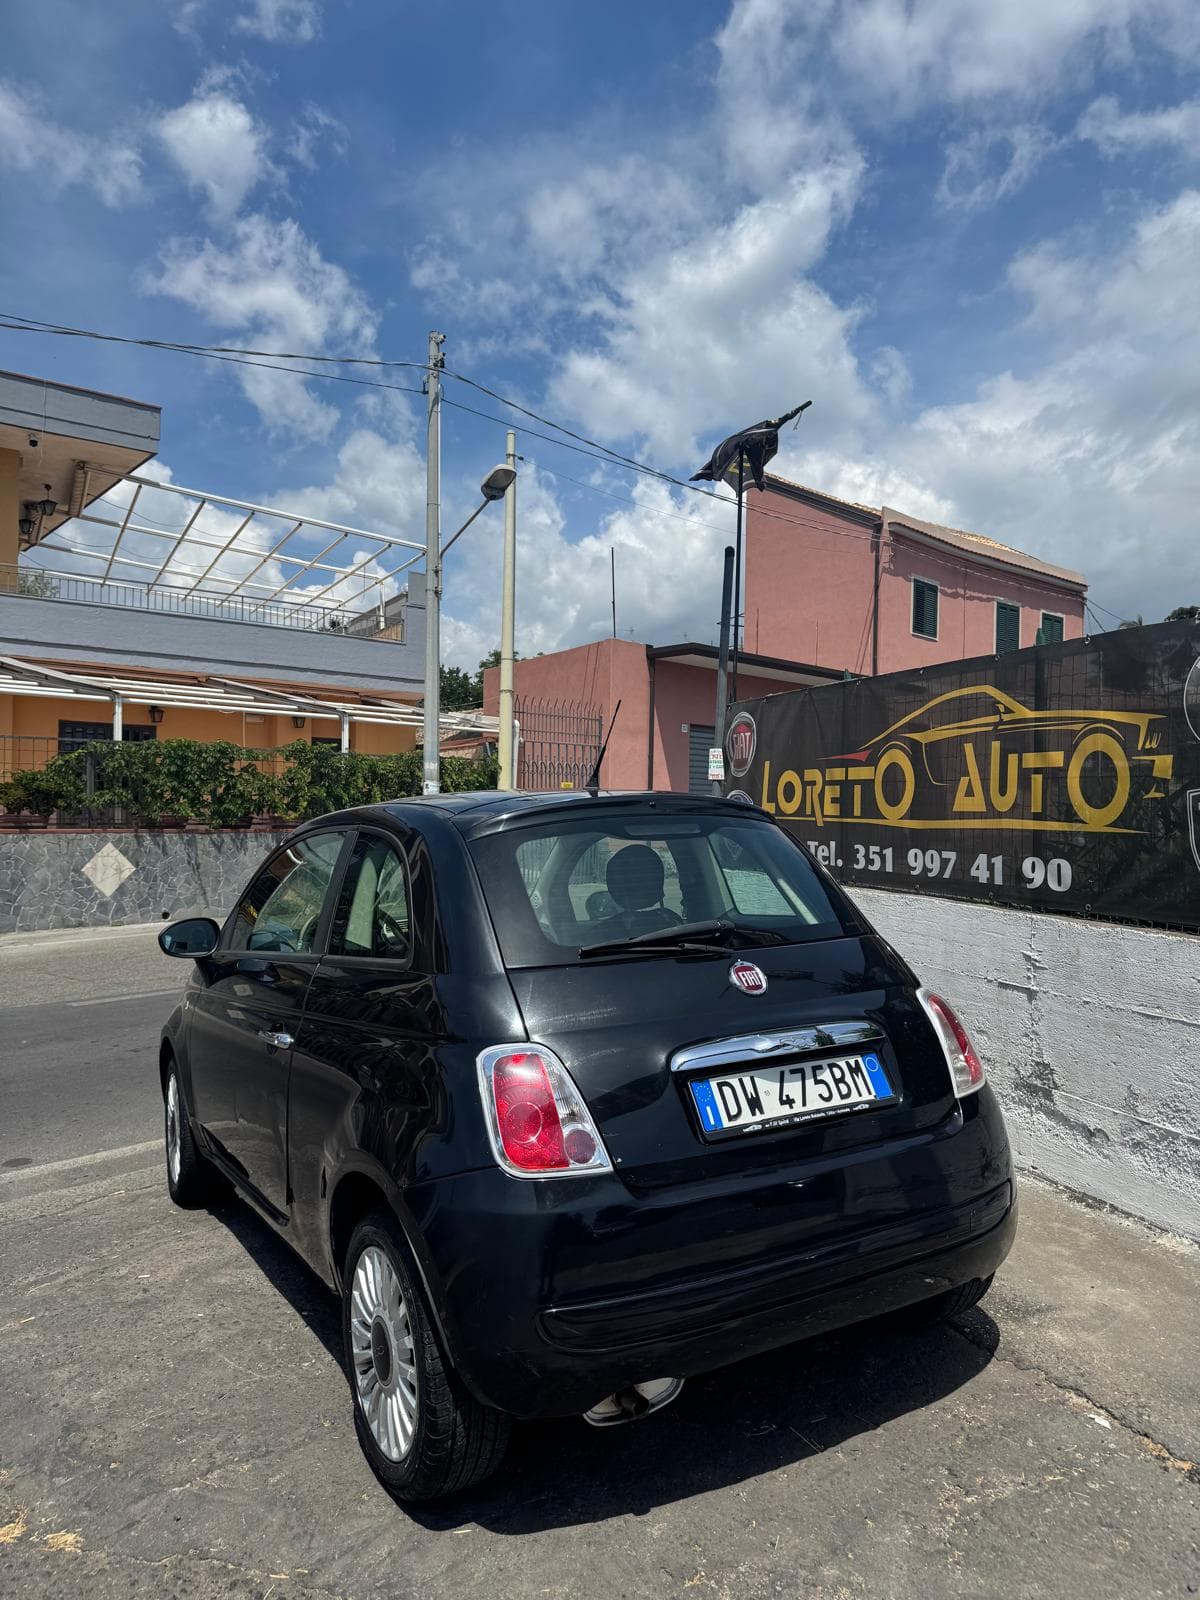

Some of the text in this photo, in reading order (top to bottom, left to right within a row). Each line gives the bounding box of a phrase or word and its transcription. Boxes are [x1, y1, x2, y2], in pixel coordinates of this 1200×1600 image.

[733, 732, 751, 760] FIAT
[762, 733, 1130, 826] LORETO AUTO
[807, 840, 1072, 892] Tel. 351 997 41 90
[738, 970, 762, 987] FIAT
[716, 1075, 765, 1122] DW
[778, 1059, 873, 1110] 475BM
